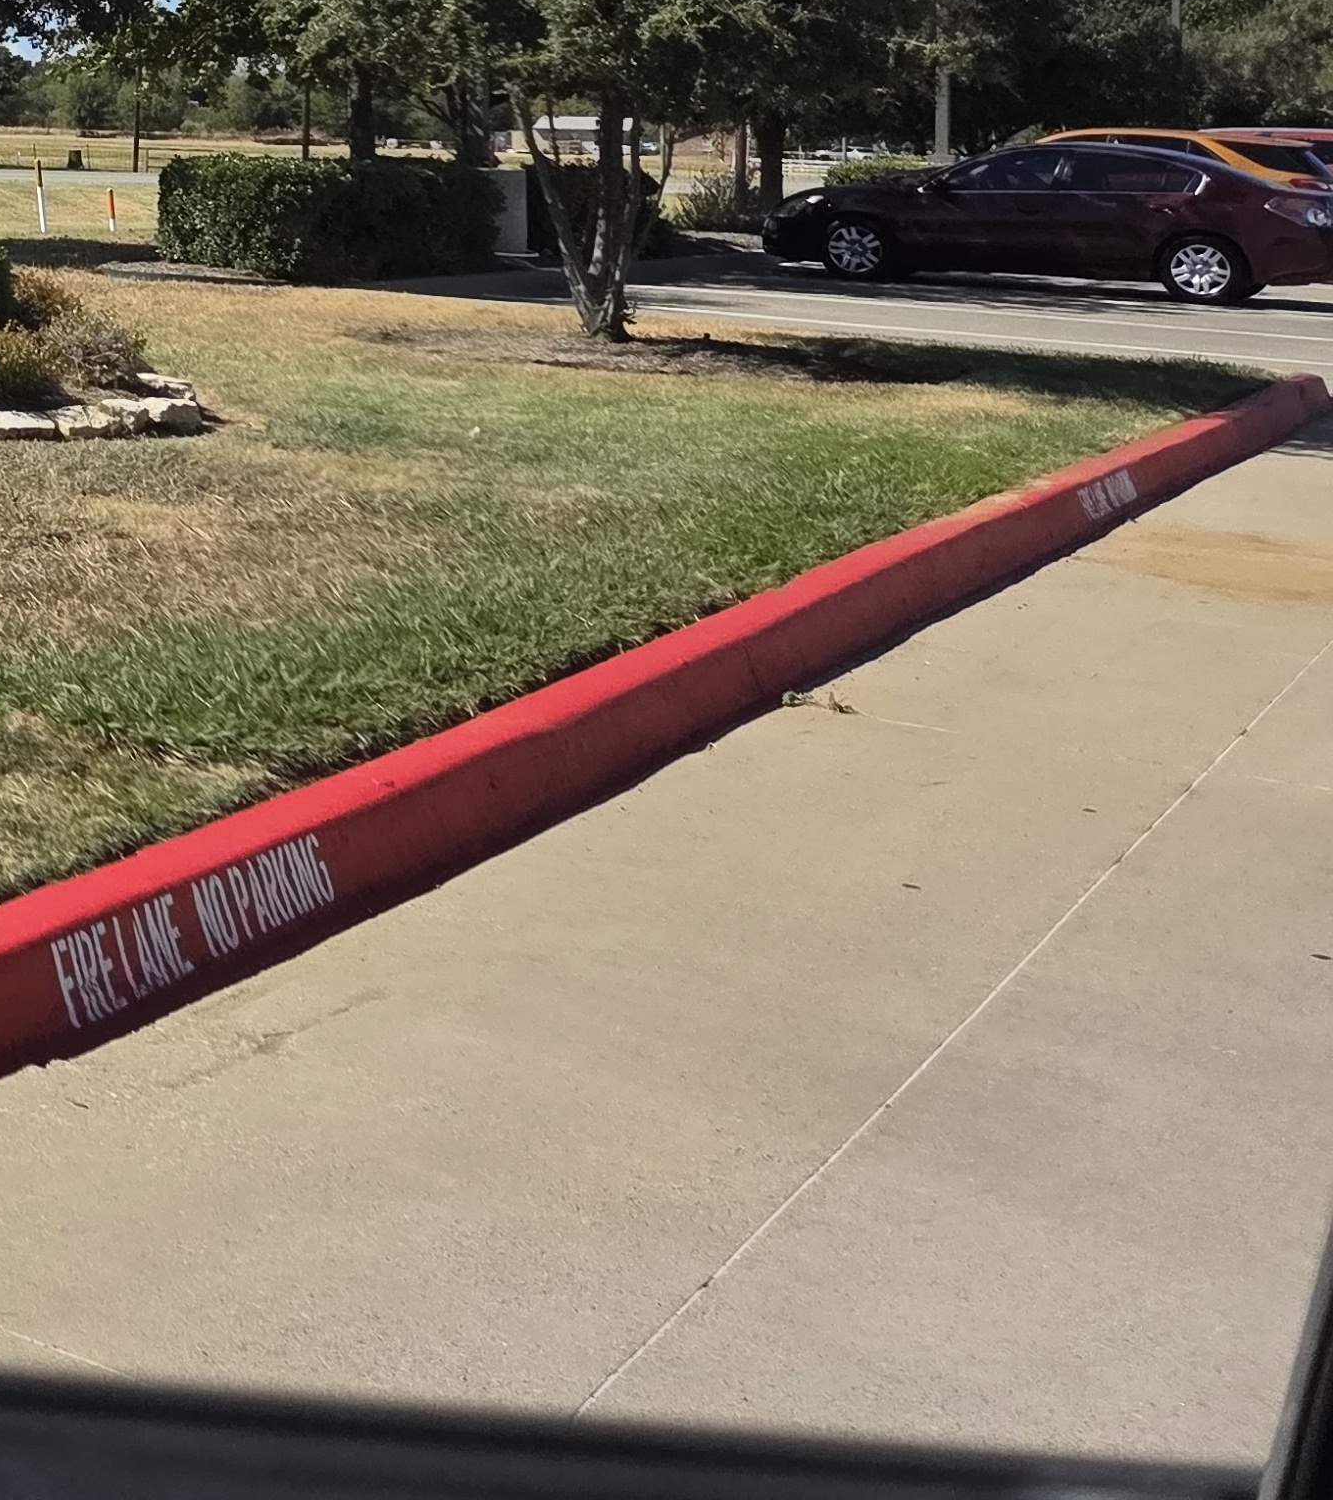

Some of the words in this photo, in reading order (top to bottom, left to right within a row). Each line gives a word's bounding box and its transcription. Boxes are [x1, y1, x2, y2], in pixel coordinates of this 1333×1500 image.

[50, 921, 129, 1029] FIRE
[112, 893, 195, 999] LANE
[191, 874, 239, 958] NO
[227, 832, 335, 940] PARKING
